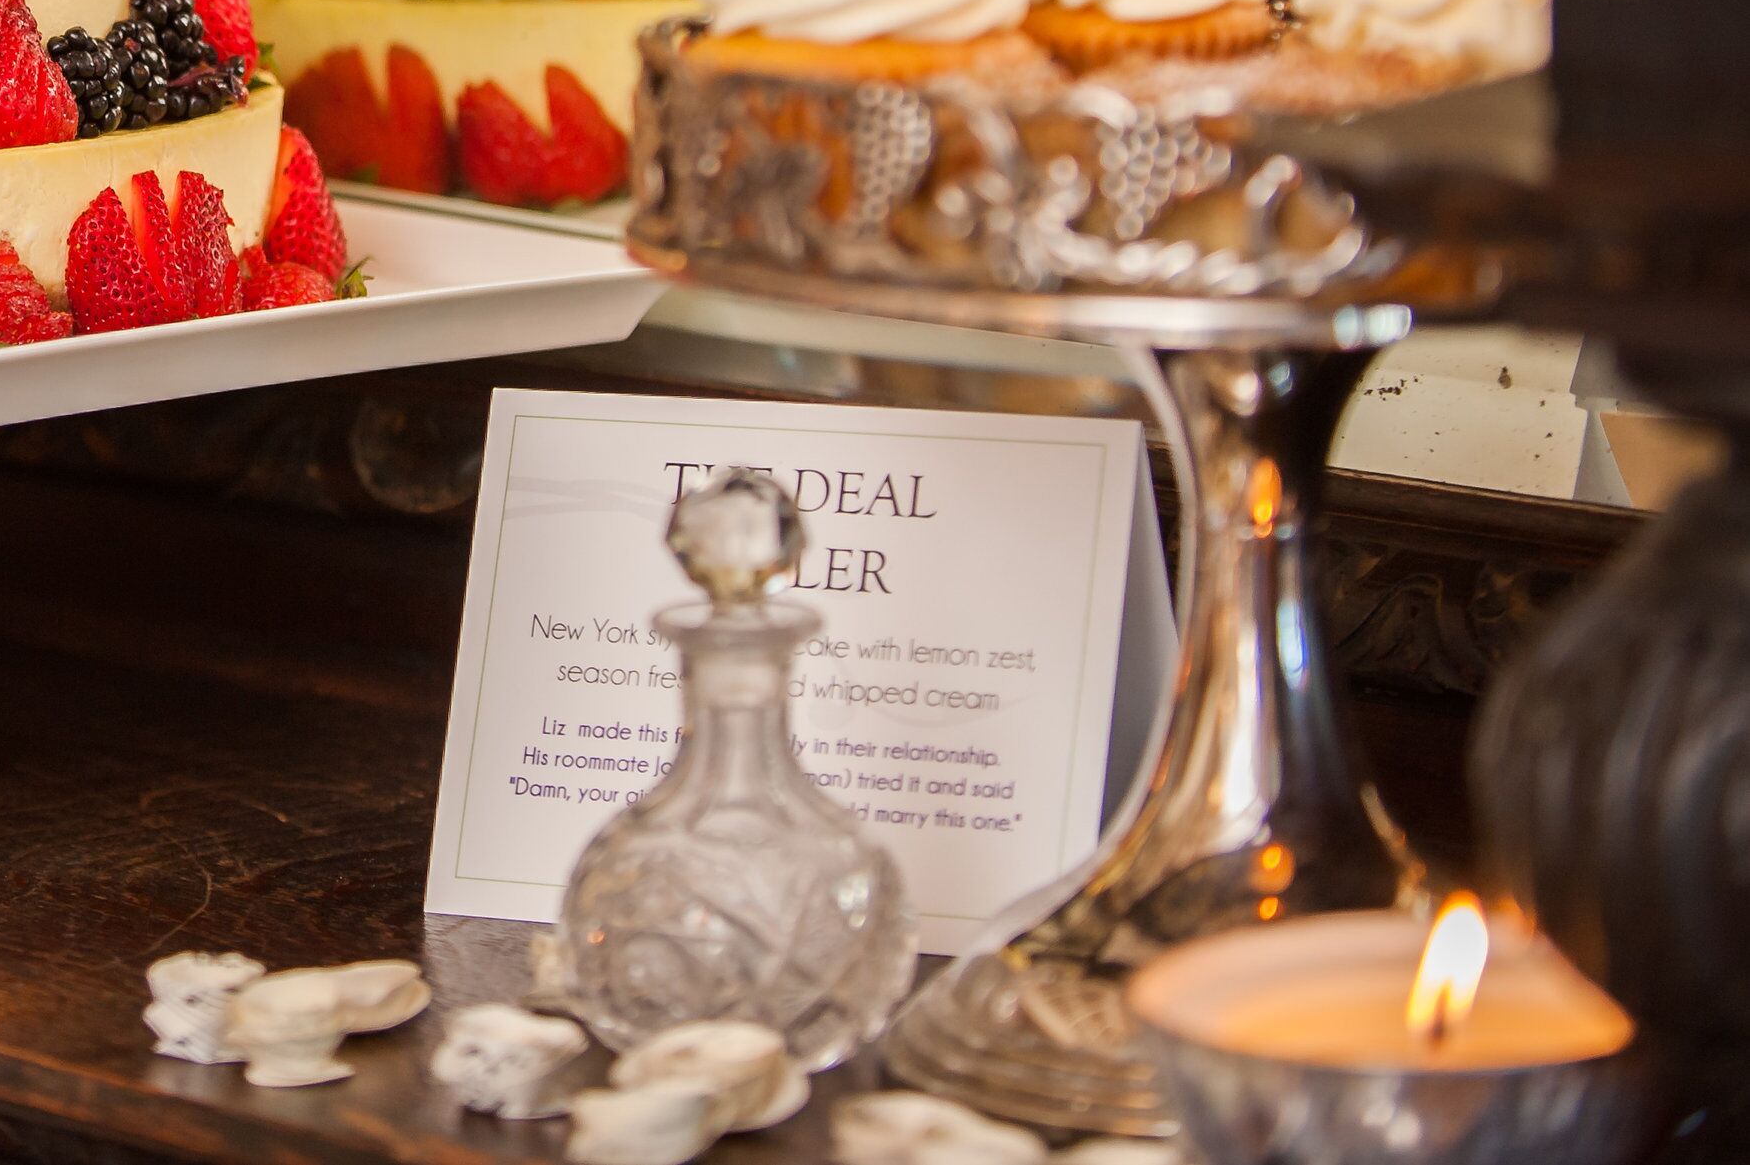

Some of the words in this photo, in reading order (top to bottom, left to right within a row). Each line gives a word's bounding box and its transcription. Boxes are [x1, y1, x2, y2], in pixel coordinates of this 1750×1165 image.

[793, 467, 938, 519] DEAL
[530, 614, 584, 640] New
[593, 618, 639, 645] York
[857, 637, 901, 662] with
[908, 638, 980, 667] lemon
[557, 664, 640, 687] season
[812, 675, 920, 707] whipped
[924, 688, 1000, 711] cream
[542, 716, 567, 736] Liz
[578, 721, 632, 741] made
[638, 723, 668, 744] this
[813, 738, 829, 754] in
[836, 737, 877, 758] their
[882, 741, 1001, 769] relationship.
[522, 746, 548, 766] His
[554, 753, 650, 774] roommate
[857, 772, 903, 792] tried
[907, 775, 921, 793] it
[926, 777, 967, 796] and
[971, 779, 1016, 800] said
[509, 776, 571, 802] "Damn,
[578, 787, 620, 804] your
[874, 808, 928, 830] marry
[934, 808, 966, 828] this
